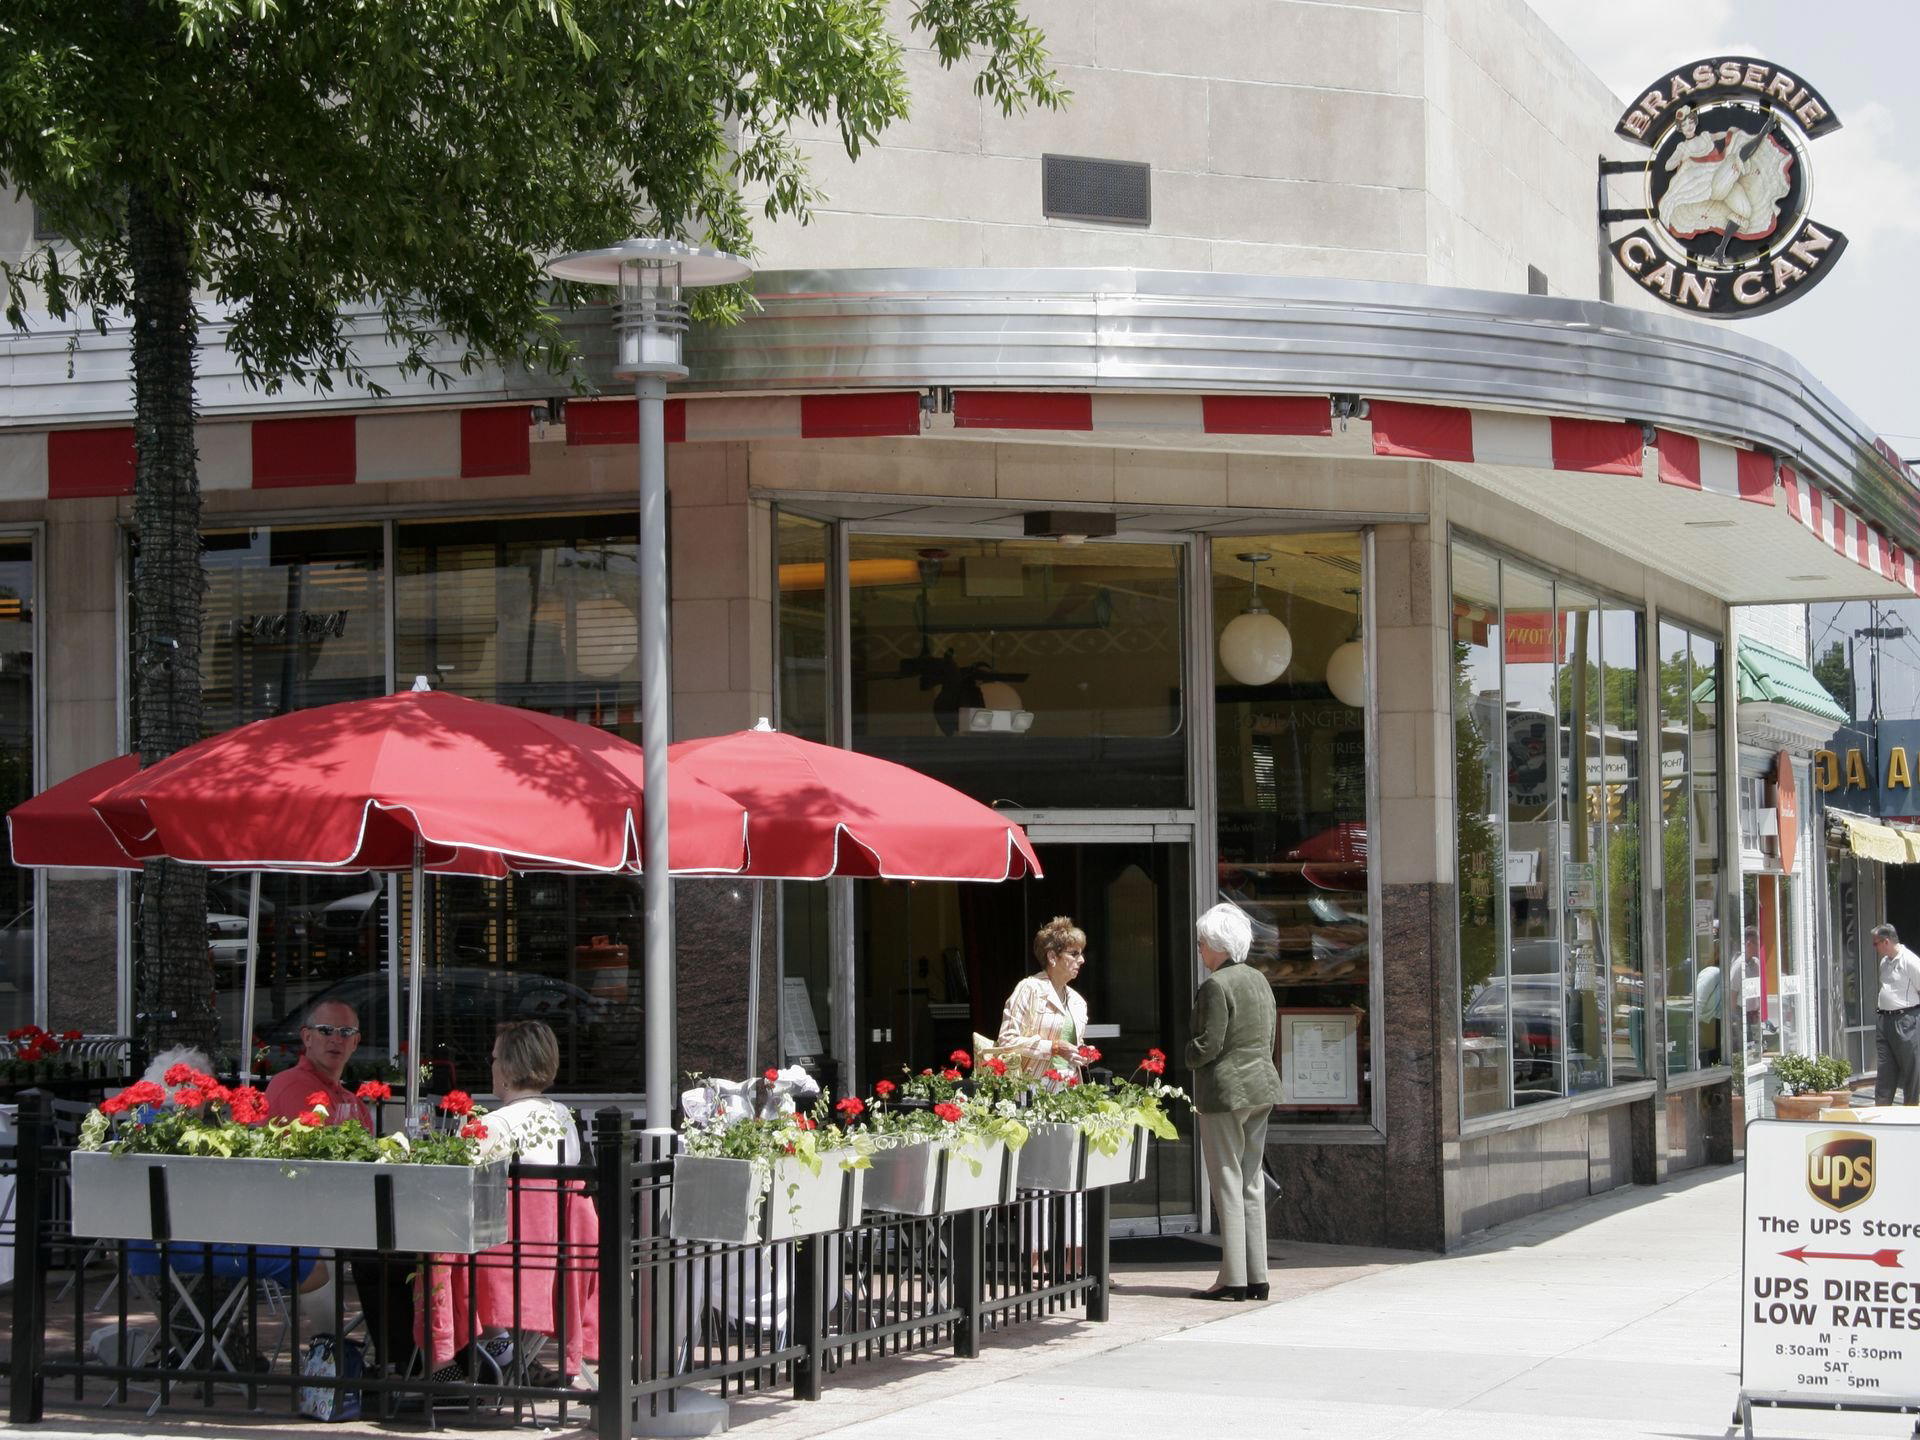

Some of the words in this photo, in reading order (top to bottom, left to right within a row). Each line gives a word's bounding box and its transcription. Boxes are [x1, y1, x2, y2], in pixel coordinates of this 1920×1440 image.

[1623, 61, 1827, 138] BRASSERIE
[1620, 236, 1717, 308] CAN
[1732, 223, 1834, 304] CAN
[1811, 1155, 1872, 1199] ups
[1758, 1216, 1800, 1233] The
[1810, 1218, 1852, 1235] UPS
[1863, 1219, 1920, 1238] Store
[1754, 1276, 1809, 1300] UPS
[1824, 1279, 1920, 1304] DIRECT
[1754, 1302, 1818, 1325] LOW
[1832, 1305, 1920, 1330] RATES
[1819, 1333, 1831, 1343] M
[1850, 1334, 1859, 1344] F
[1775, 1344, 1829, 1357] 8:30am
[1848, 1347, 1903, 1361] 6:30pm
[1823, 1361, 1853, 1374] SAT.
[1797, 1373, 1829, 1386] 9am
[1847, 1376, 1880, 1388] 5pm
